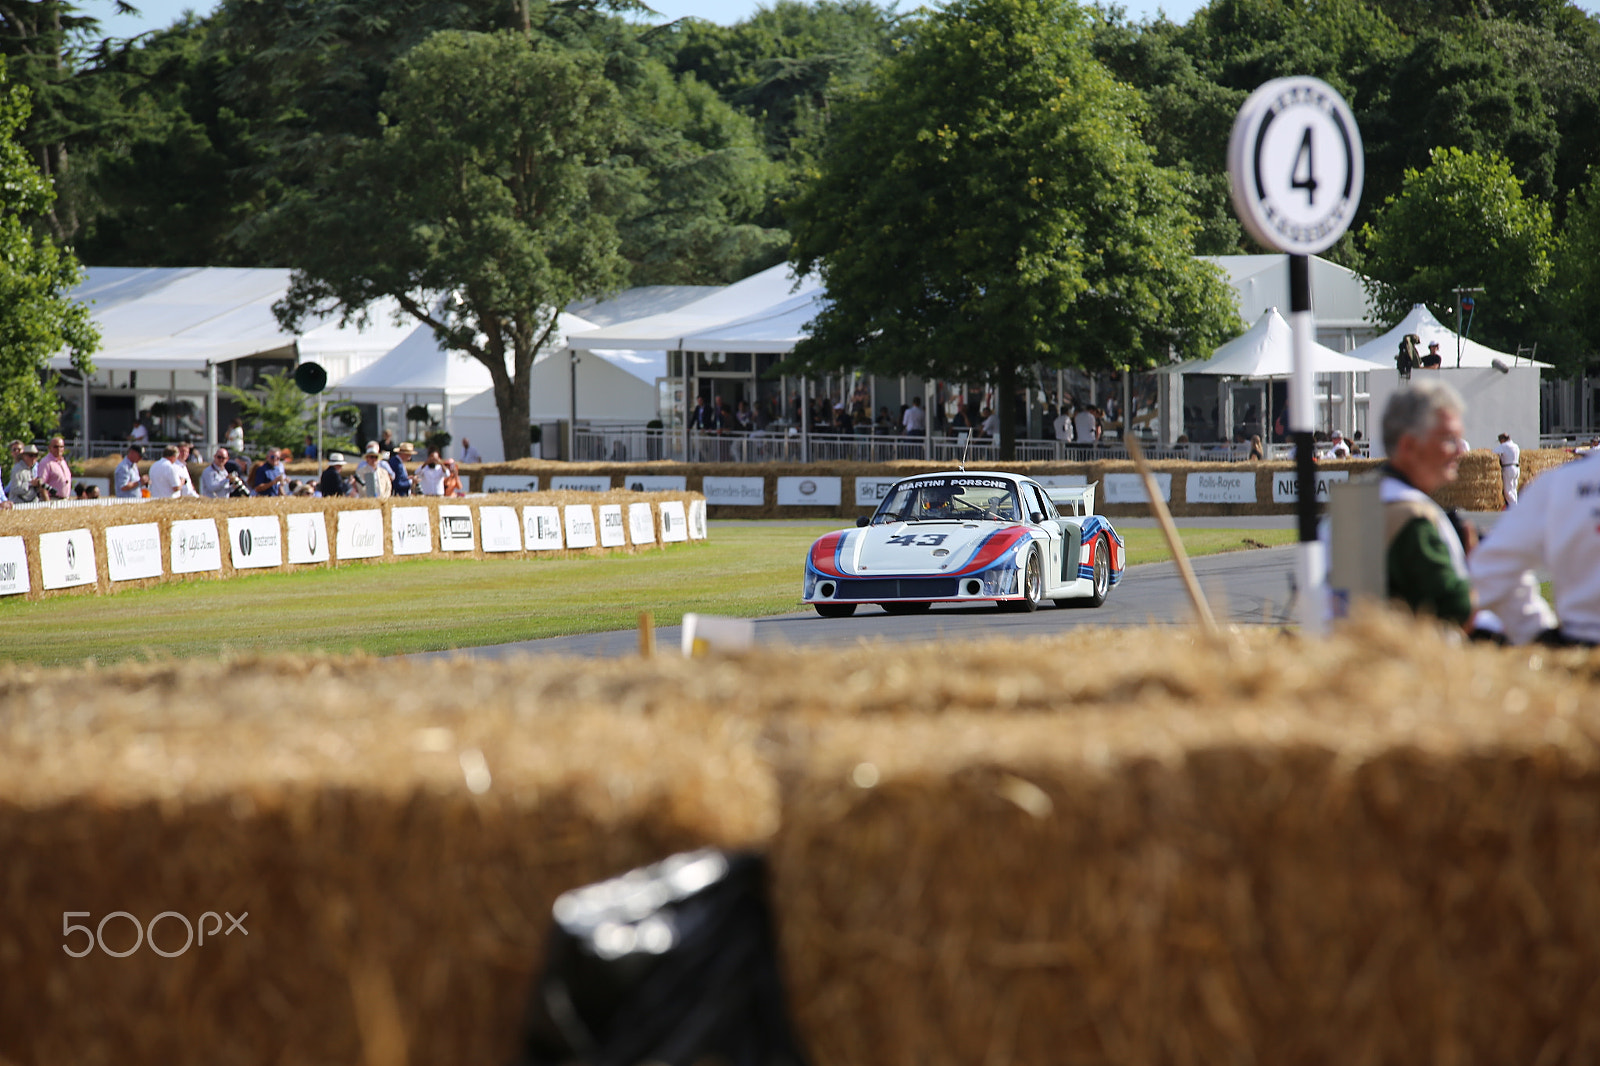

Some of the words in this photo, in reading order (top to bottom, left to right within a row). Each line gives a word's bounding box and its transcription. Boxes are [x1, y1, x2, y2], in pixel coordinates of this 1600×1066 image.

[1291, 125, 1318, 206] 4
[898, 480, 945, 491] MARTINI
[950, 479, 1007, 489] PORSCHE
[1198, 475, 1241, 491] Rolls-Royce
[351, 521, 376, 548] Cartier
[886, 534, 950, 546] 43
